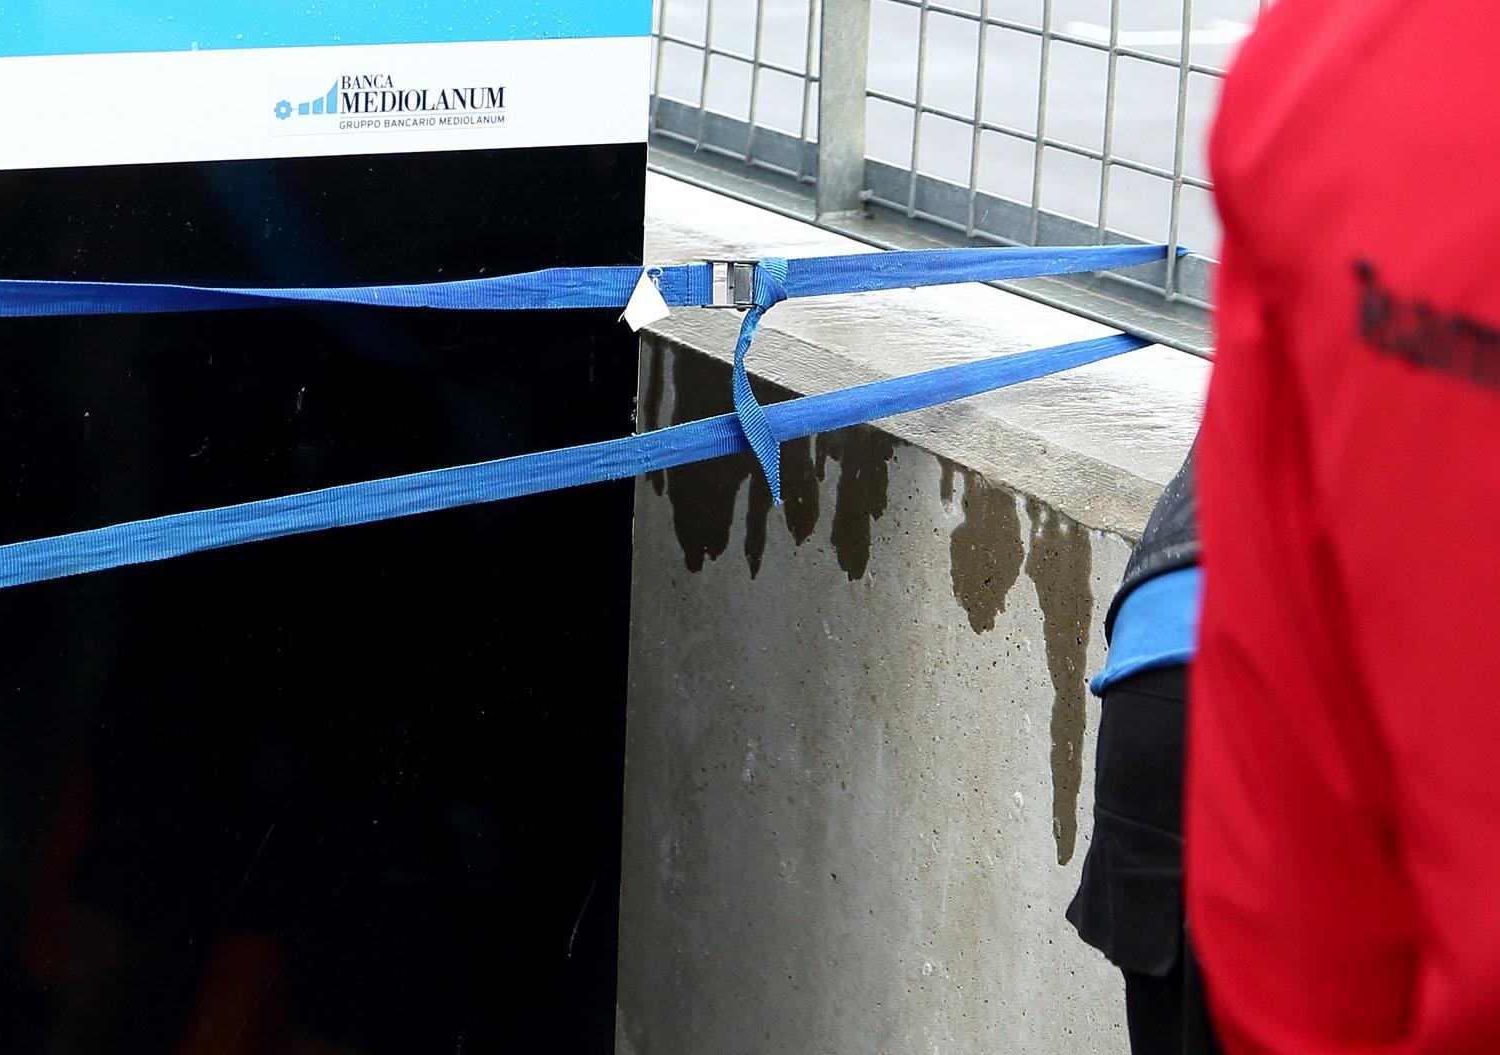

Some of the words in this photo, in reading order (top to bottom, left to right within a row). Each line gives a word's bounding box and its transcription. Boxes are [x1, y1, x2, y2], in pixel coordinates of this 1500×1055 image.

[341, 74, 393, 90] BANCA
[341, 86, 506, 113] MEDIOLANUM
[339, 120, 381, 130] GRUPPO
[384, 118, 436, 128] BANCARIO
[439, 116, 505, 126] MEDIOLANUM
